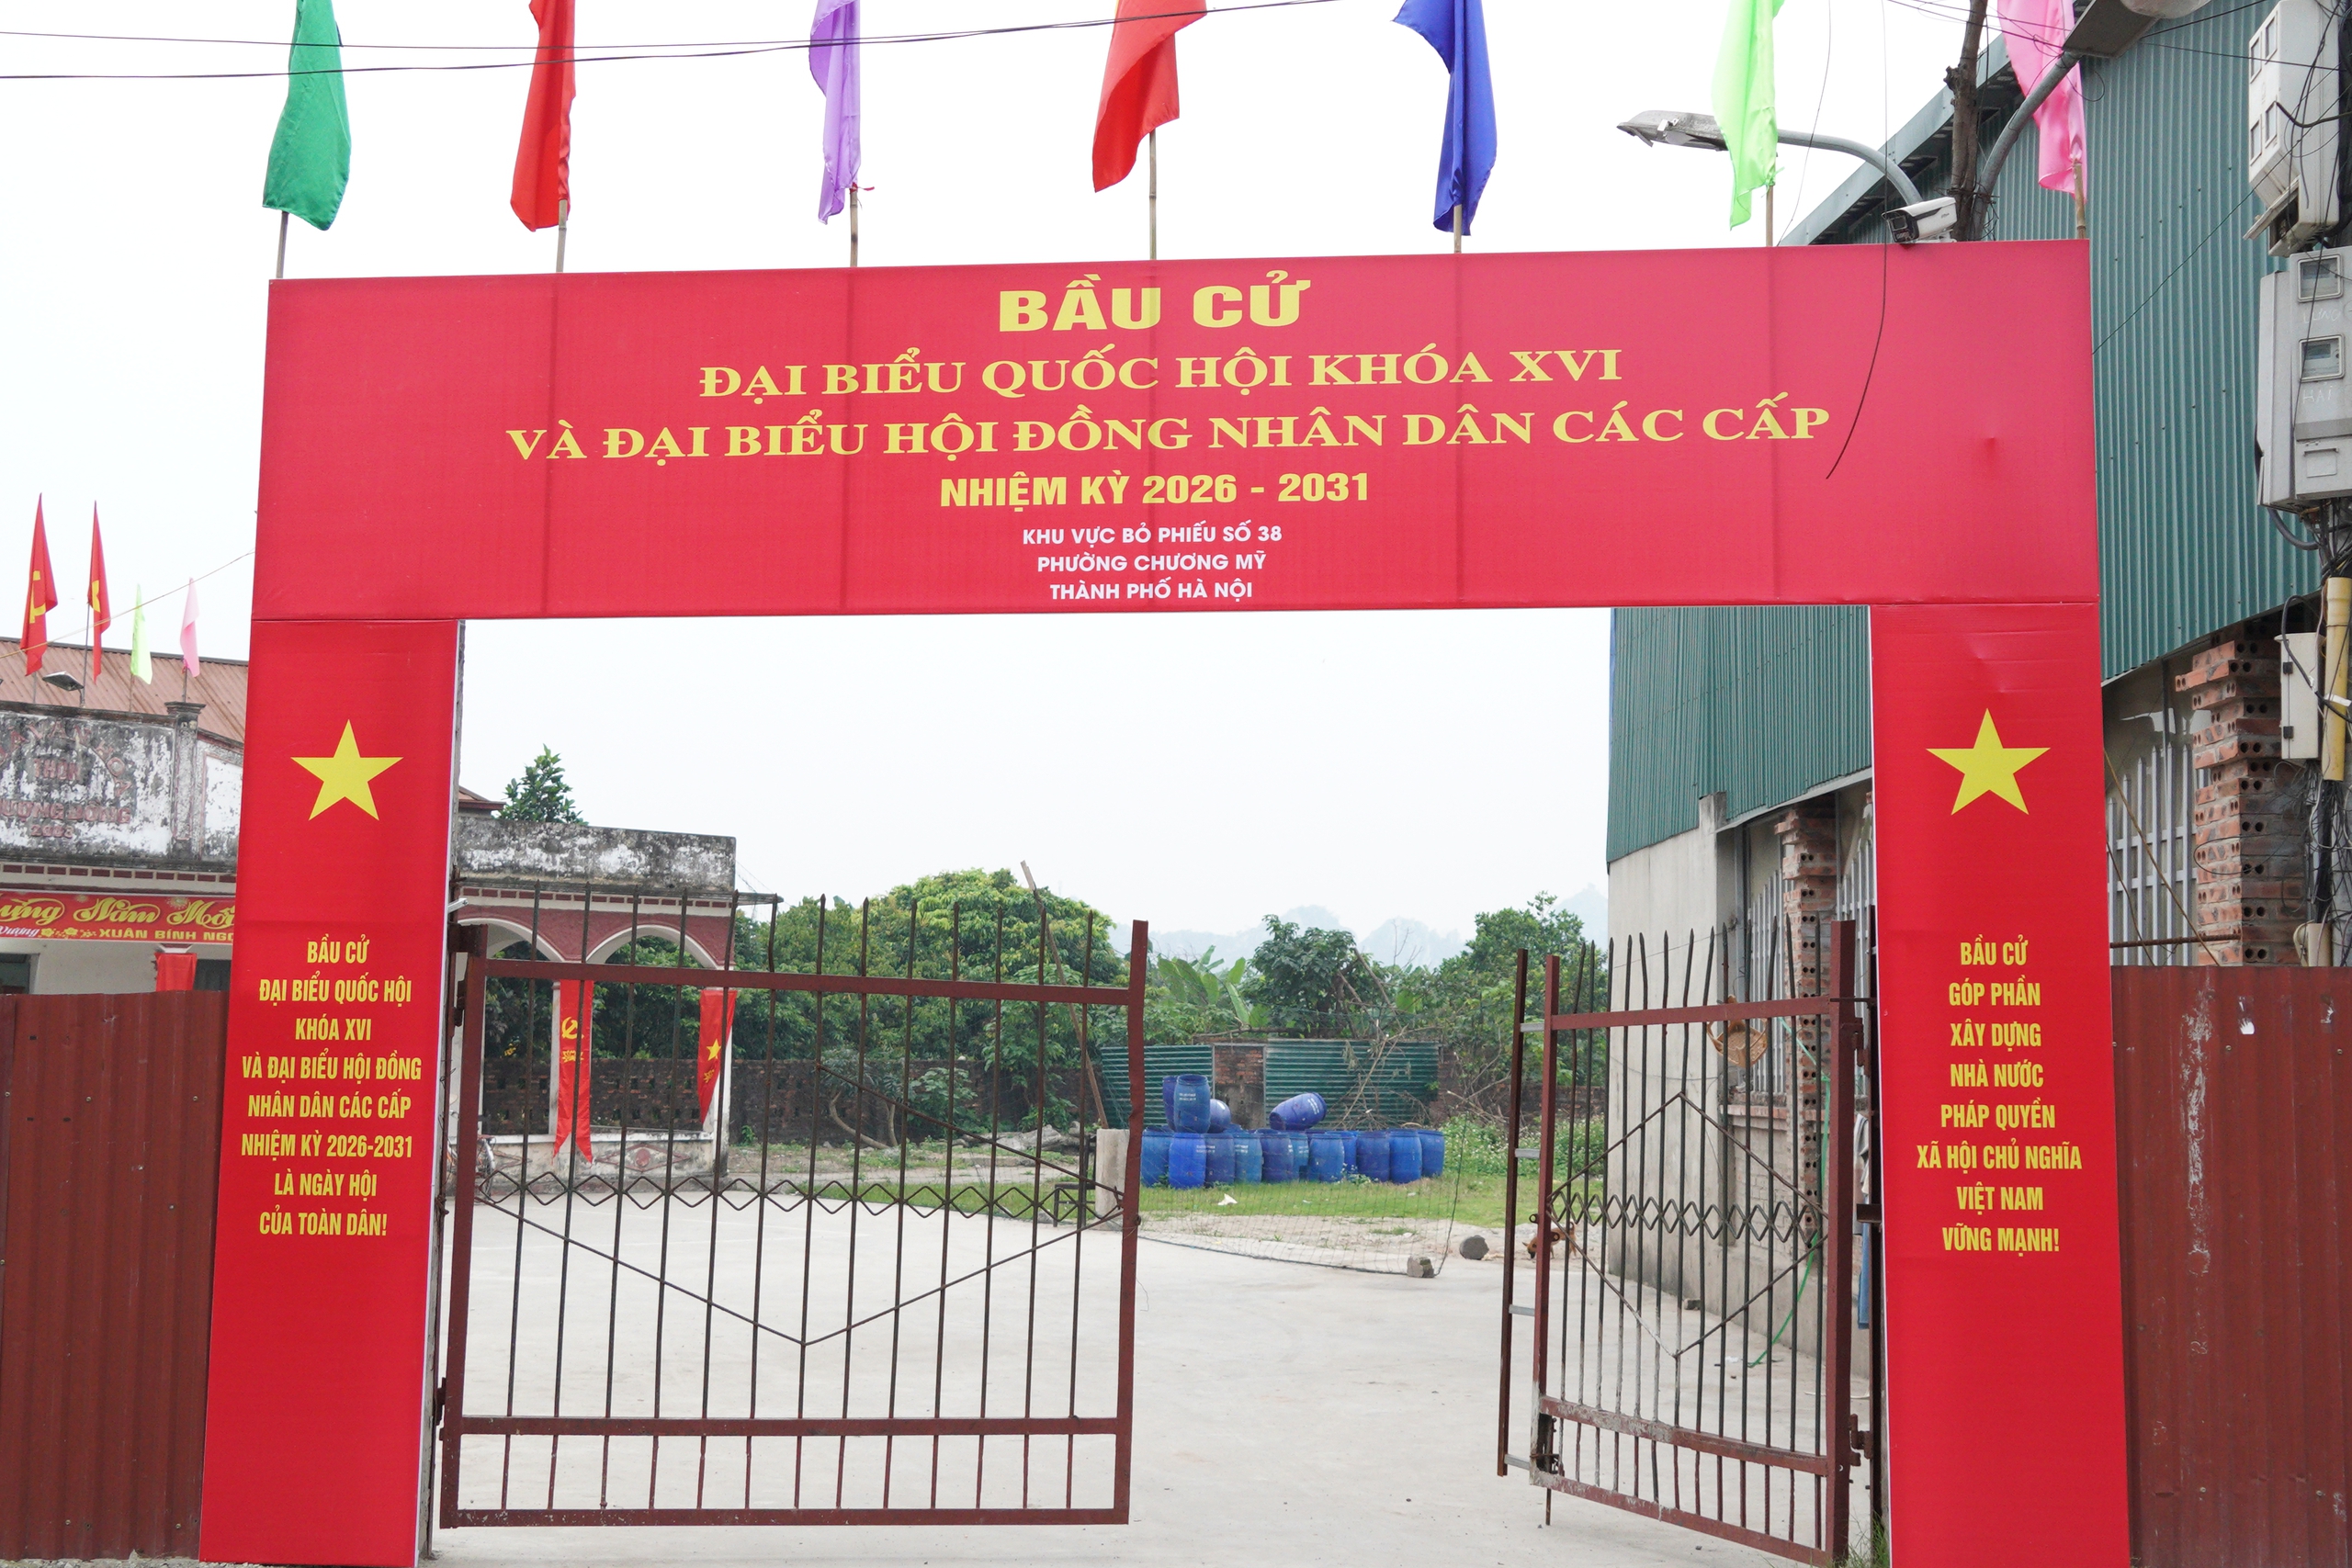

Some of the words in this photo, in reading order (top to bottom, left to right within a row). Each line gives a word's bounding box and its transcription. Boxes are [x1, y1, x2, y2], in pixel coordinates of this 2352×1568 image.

[1000, 274, 1160, 332] BẦU
[1193, 270, 1310, 327] CỬ
[700, 366, 807, 404] ĐẠI
[822, 347, 966, 394] BIỂU
[982, 344, 1158, 398] QUỐC
[1176, 347, 1292, 395] HỘI
[1309, 344, 1492, 385] KHÓA
[1510, 350, 1622, 381] XVI
[506, 420, 587, 459] VÀ
[603, 427, 709, 466] ĐẠI
[725, 410, 868, 456] BIỂU
[884, 413, 998, 461] HỘI
[1013, 404, 1193, 451] ĐỒNG
[1209, 407, 1386, 447] NHÂN
[1403, 404, 1534, 445] DÂN
[1554, 400, 1683, 443] CÁC
[1703, 392, 1829, 440] CẤP
[941, 472, 1066, 512] NHIỆM
[1081, 470, 1129, 504] KỲ
[1143, 475, 1236, 503] 2026
[1278, 473, 1367, 502] 2031
[1023, 529, 1064, 544] KHU
[1071, 526, 1114, 547] VỰC
[1123, 523, 1151, 543] BỎ
[1159, 521, 1216, 542] PHIẾU
[1223, 520, 1250, 541] SỐ
[1259, 526, 1282, 541] 38
[1038, 552, 1127, 571] PHƯỜNG
[1135, 553, 1228, 570] CHƯƠNG
[1237, 550, 1266, 569] MỸ
[1050, 580, 1119, 599] THÀNH
[1127, 577, 1170, 598] PHỐ
[1179, 579, 1207, 598] HÀ
[1215, 578, 1251, 602] NỘI
[0, 894, 65, 926] ừng
[99, 927, 147, 938] XUÂN
[154, 929, 197, 940] BÍNH
[308, 934, 340, 963] BẦU
[345, 934, 369, 963] CỬ
[1961, 934, 1996, 964] BẦU
[2003, 935, 2028, 965] CỬ
[260, 979, 287, 1006] ĐẠI
[292, 971, 329, 1001] BIỂU
[335, 973, 379, 1004] QUỐC
[384, 976, 411, 1007] HỘI
[1950, 978, 1984, 1006] GÓP
[1991, 975, 2040, 1005] PHẦN
[296, 1014, 339, 1040] KHÓA
[345, 1019, 371, 1040] XVI
[1951, 1019, 1985, 1045] XÂY
[1992, 1021, 2041, 1051] DỰNG
[243, 1052, 262, 1077] VÀ
[267, 1056, 295, 1083] ĐẠI
[300, 1048, 337, 1078] BIỂU
[344, 1053, 370, 1084] HỘI
[376, 1050, 421, 1079] ĐỒNG
[1951, 1059, 1988, 1087] NHÀ
[1995, 1059, 2043, 1087] NƯỚC
[248, 1090, 294, 1117] NHÂN
[300, 1091, 334, 1117] DÂN
[340, 1091, 372, 1118] CÁC
[379, 1089, 411, 1118] CẤP
[1941, 1100, 1989, 1127] PHÁP
[1996, 1098, 2054, 1130] QUYỀN
[242, 1130, 295, 1160] NHIỆM
[301, 1130, 322, 1156] KỲ
[327, 1135, 412, 1157] 2026-2031
[1917, 1141, 1941, 1168] XÃ
[1947, 1141, 1976, 1174] HỘI
[1984, 1138, 2018, 1168] CHỦ
[2026, 1142, 2082, 1168] NGHĨA
[275, 1168, 293, 1195] LÀ
[300, 1169, 344, 1195] NGÀY
[349, 1169, 377, 1201] HỘI
[1957, 1181, 1995, 1214] VIỆT
[2001, 1187, 2042, 1210] NAM
[260, 1205, 292, 1235] CỦA
[299, 1208, 341, 1235] TOÀN
[347, 1209, 387, 1235] DÂN!
[1942, 1223, 1991, 1251] VỮNG
[1998, 1228, 2059, 1257] MẠNH!
